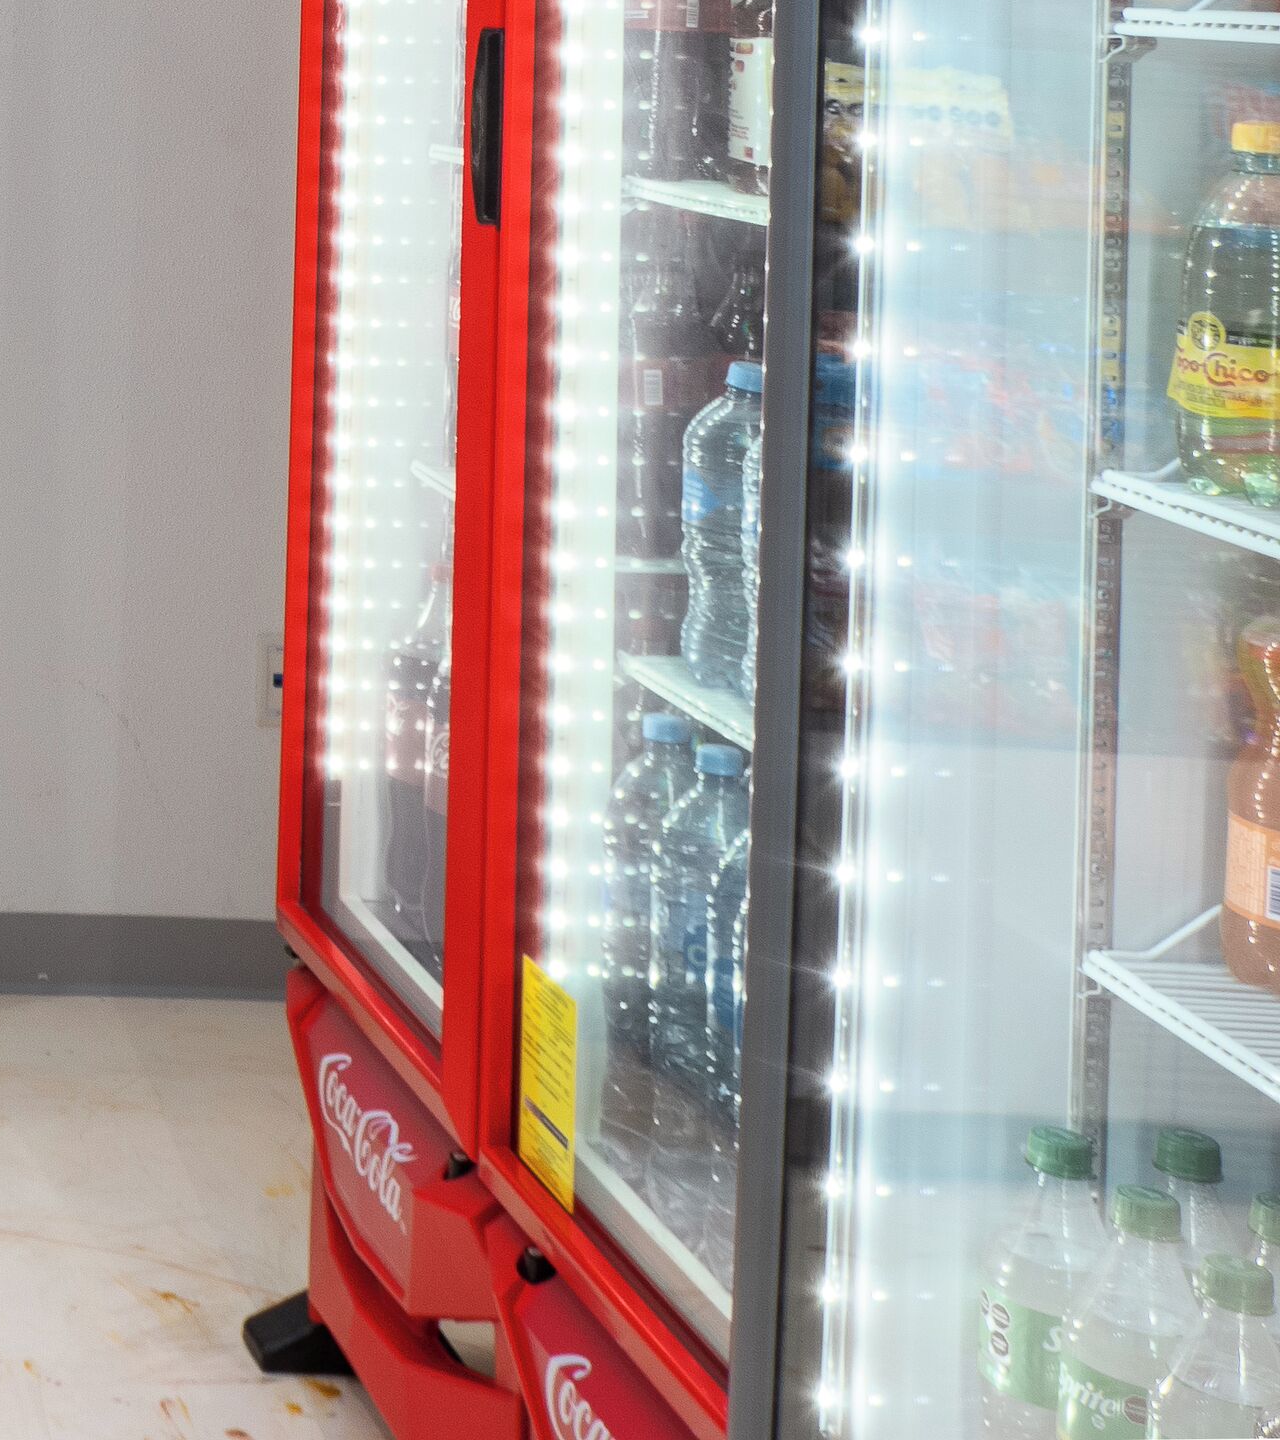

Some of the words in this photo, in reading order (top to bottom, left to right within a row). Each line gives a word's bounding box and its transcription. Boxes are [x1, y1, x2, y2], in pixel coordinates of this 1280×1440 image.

[1203, 352, 1270, 387] Chico
[318, 1053, 417, 1224] Coca-Cola
[1058, 1361, 1126, 1415] prite
